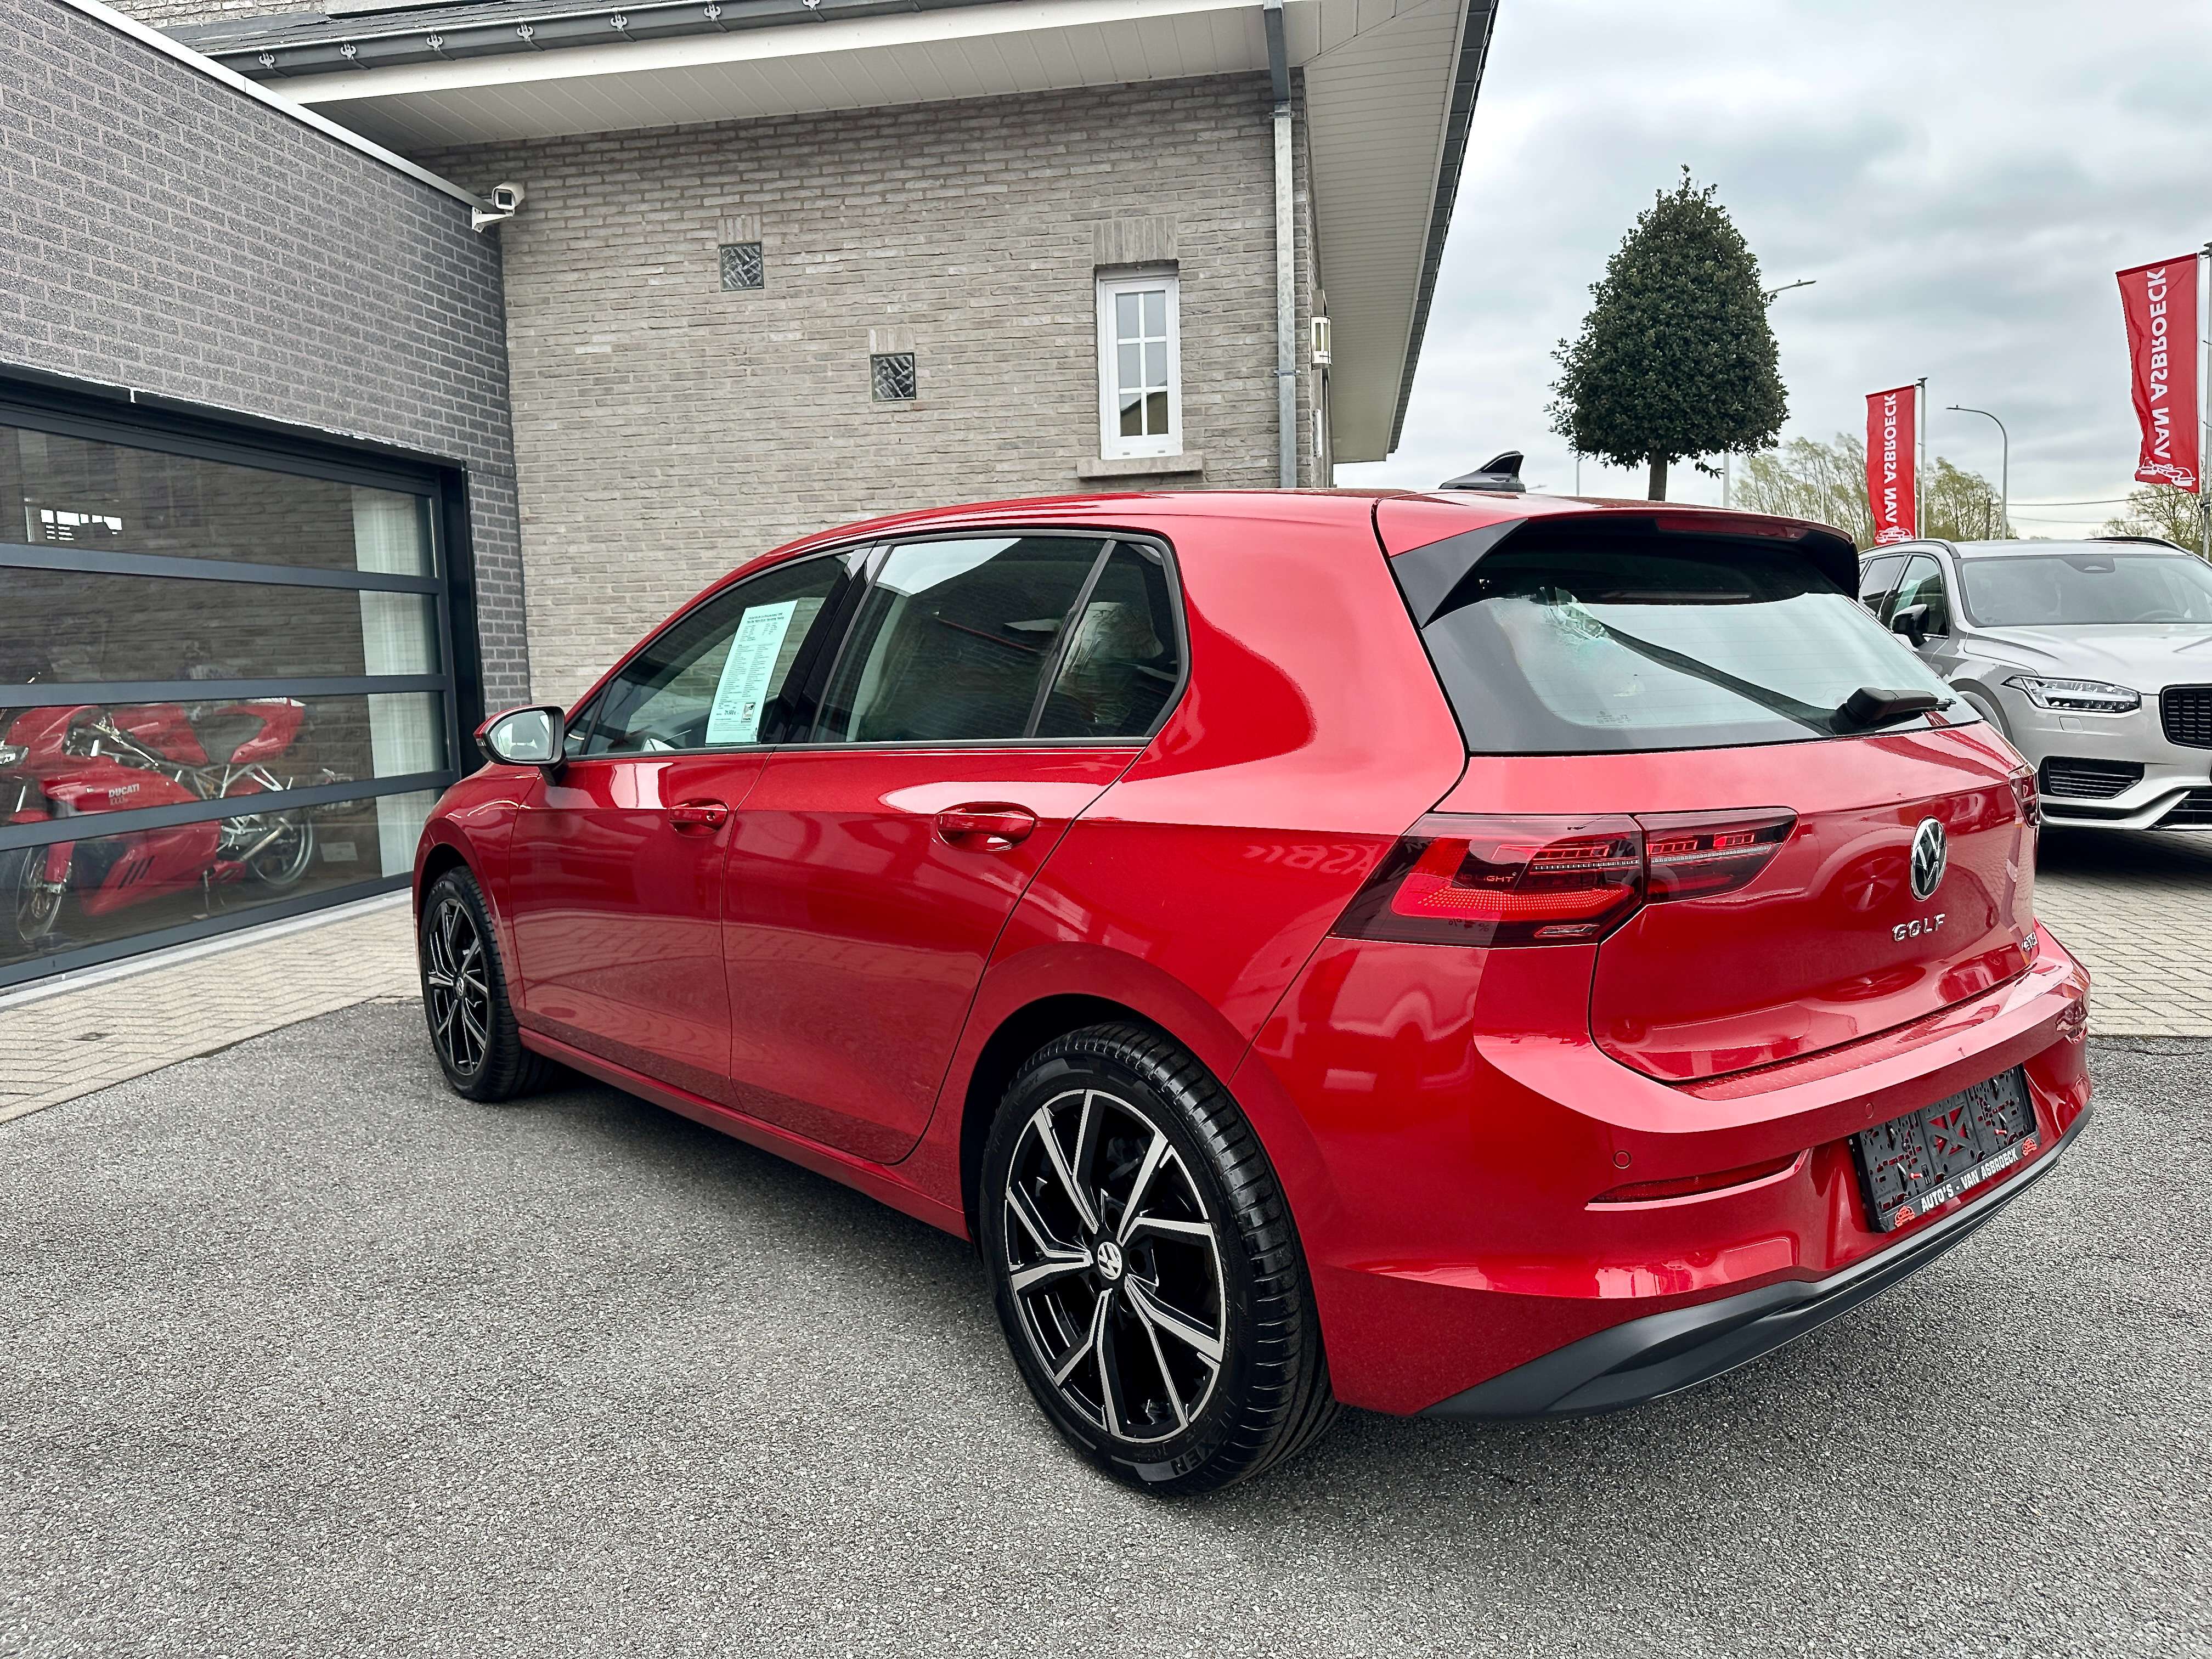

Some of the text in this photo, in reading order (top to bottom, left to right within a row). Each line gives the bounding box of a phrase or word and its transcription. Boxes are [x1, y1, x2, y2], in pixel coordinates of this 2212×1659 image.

[108, 783, 139, 798] DUCATI
[1892, 913, 1945, 942] GOLF
[1921, 1183, 1954, 1213] AUTO'S
[1960, 1170, 1980, 1189] VAN
[1980, 1148, 2019, 1180] ASBROECK
